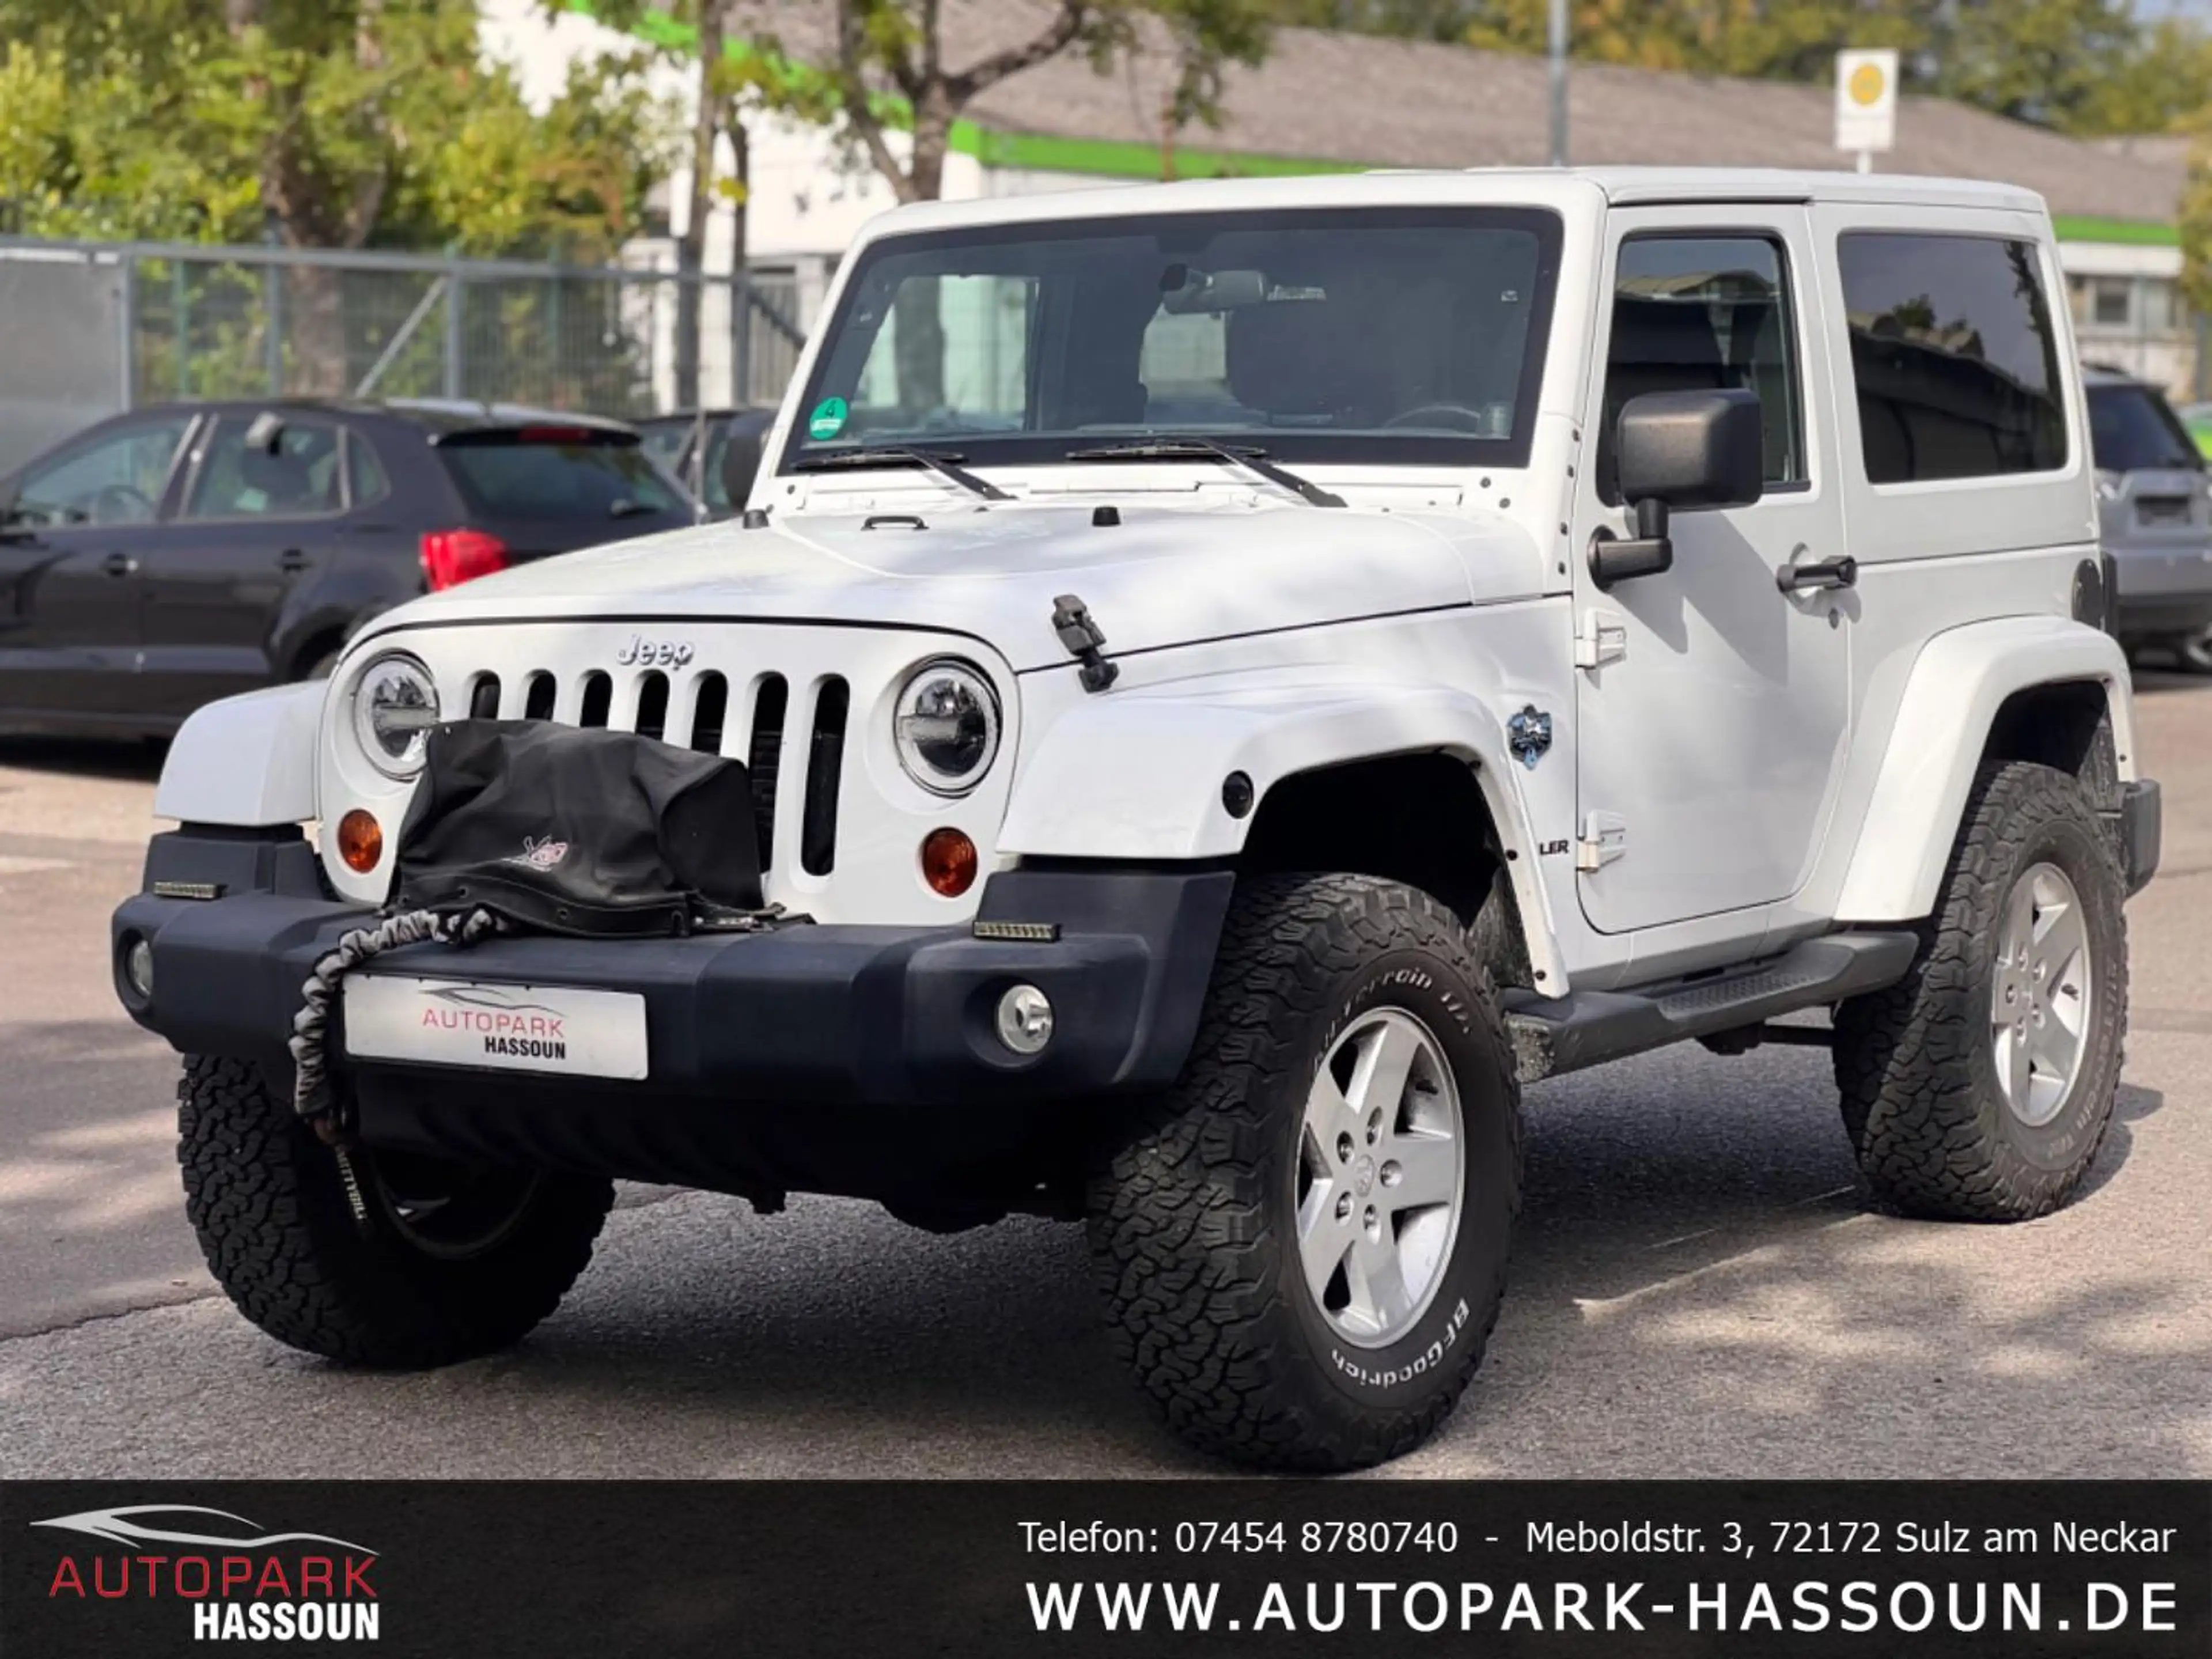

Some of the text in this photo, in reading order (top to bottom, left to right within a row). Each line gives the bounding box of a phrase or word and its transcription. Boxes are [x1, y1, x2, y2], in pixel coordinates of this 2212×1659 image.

[616, 633, 695, 671] Jeep
[422, 1009, 564, 1037] AUTOPARK
[484, 1036, 566, 1059] HASSOUN
[1331, 1297, 1469, 1388] BFGoodrich
